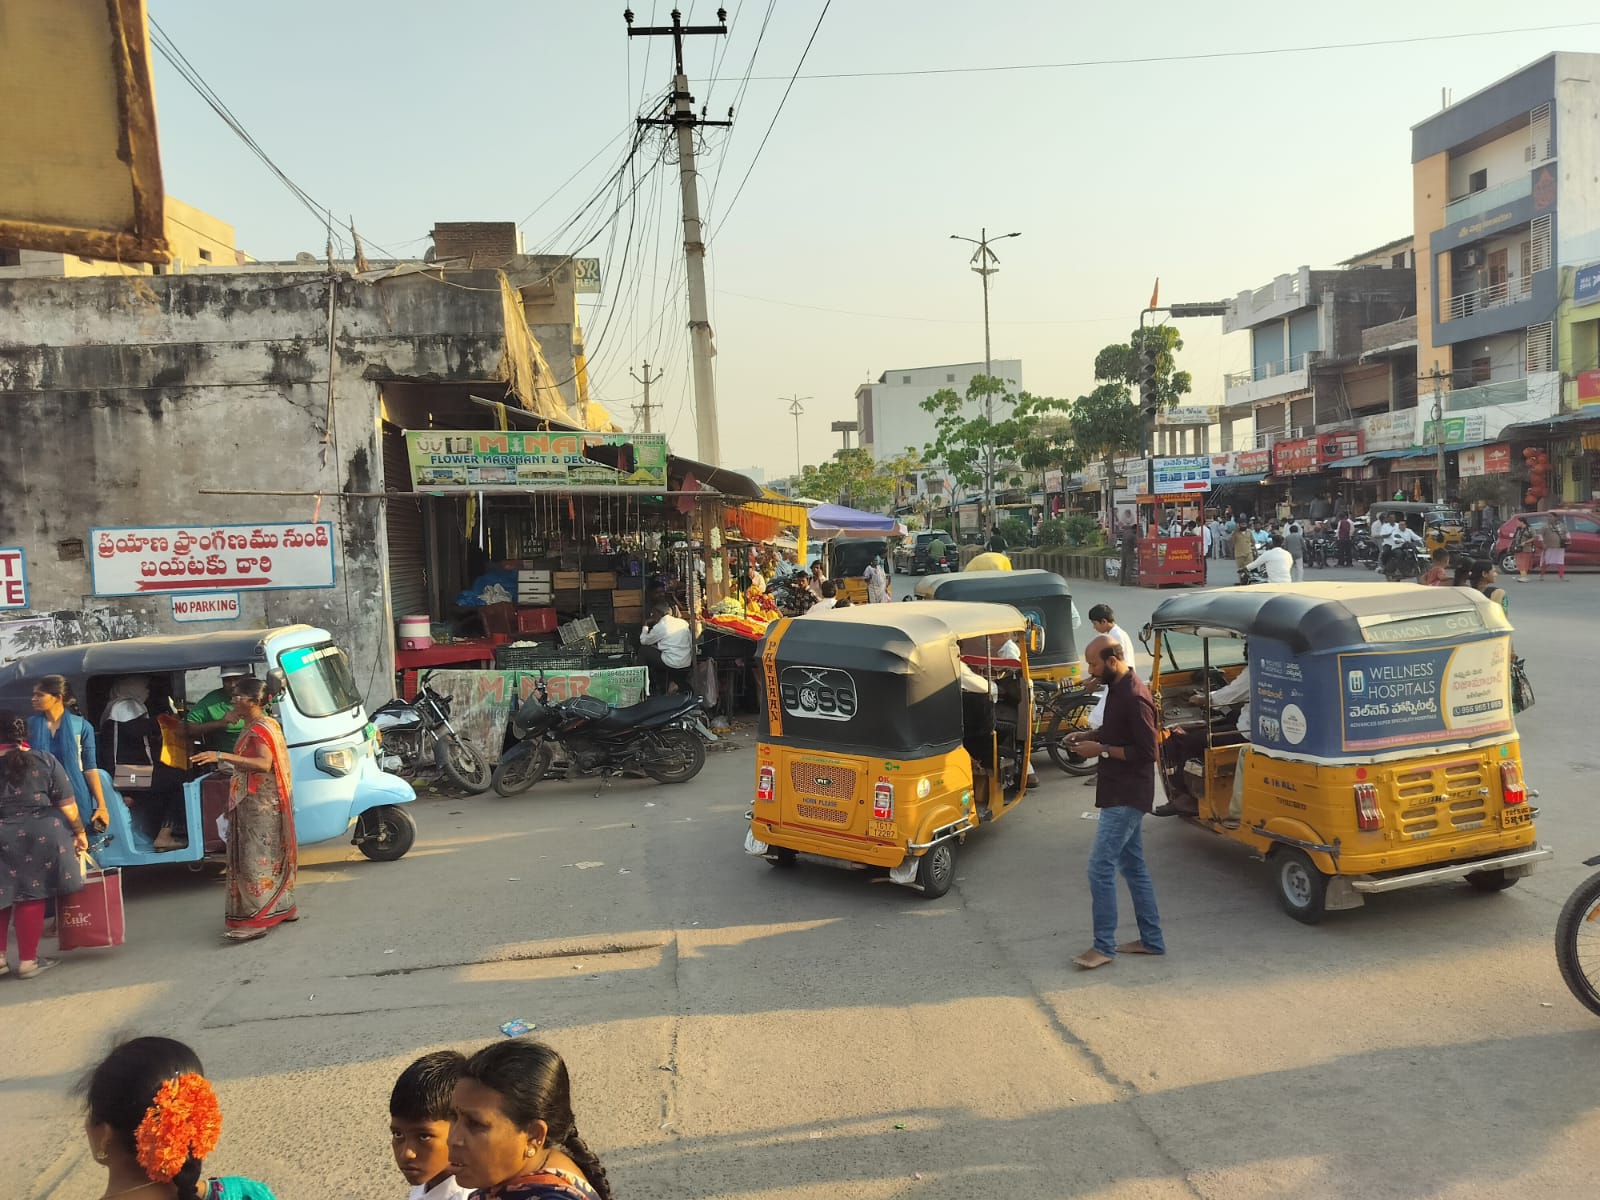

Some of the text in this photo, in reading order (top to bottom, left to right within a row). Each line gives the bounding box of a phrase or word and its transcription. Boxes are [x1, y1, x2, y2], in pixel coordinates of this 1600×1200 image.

[576, 259, 599, 278] SR
[431, 455, 479, 465] FLOWER
[552, 455, 559, 464] &
[98, 526, 329, 558] ప్రయాణ ప్రాంగణము నుండి
[140, 554, 273, 577] బయటకు దారి
[0, 580, 24, 604] E
[174, 599, 237, 614] NO PARKING
[1369, 662, 1434, 680] WELLNESS
[1368, 680, 1436, 700] HOSPITALS
[781, 684, 855, 716] BOSS
[876, 821, 893, 830] TG17
